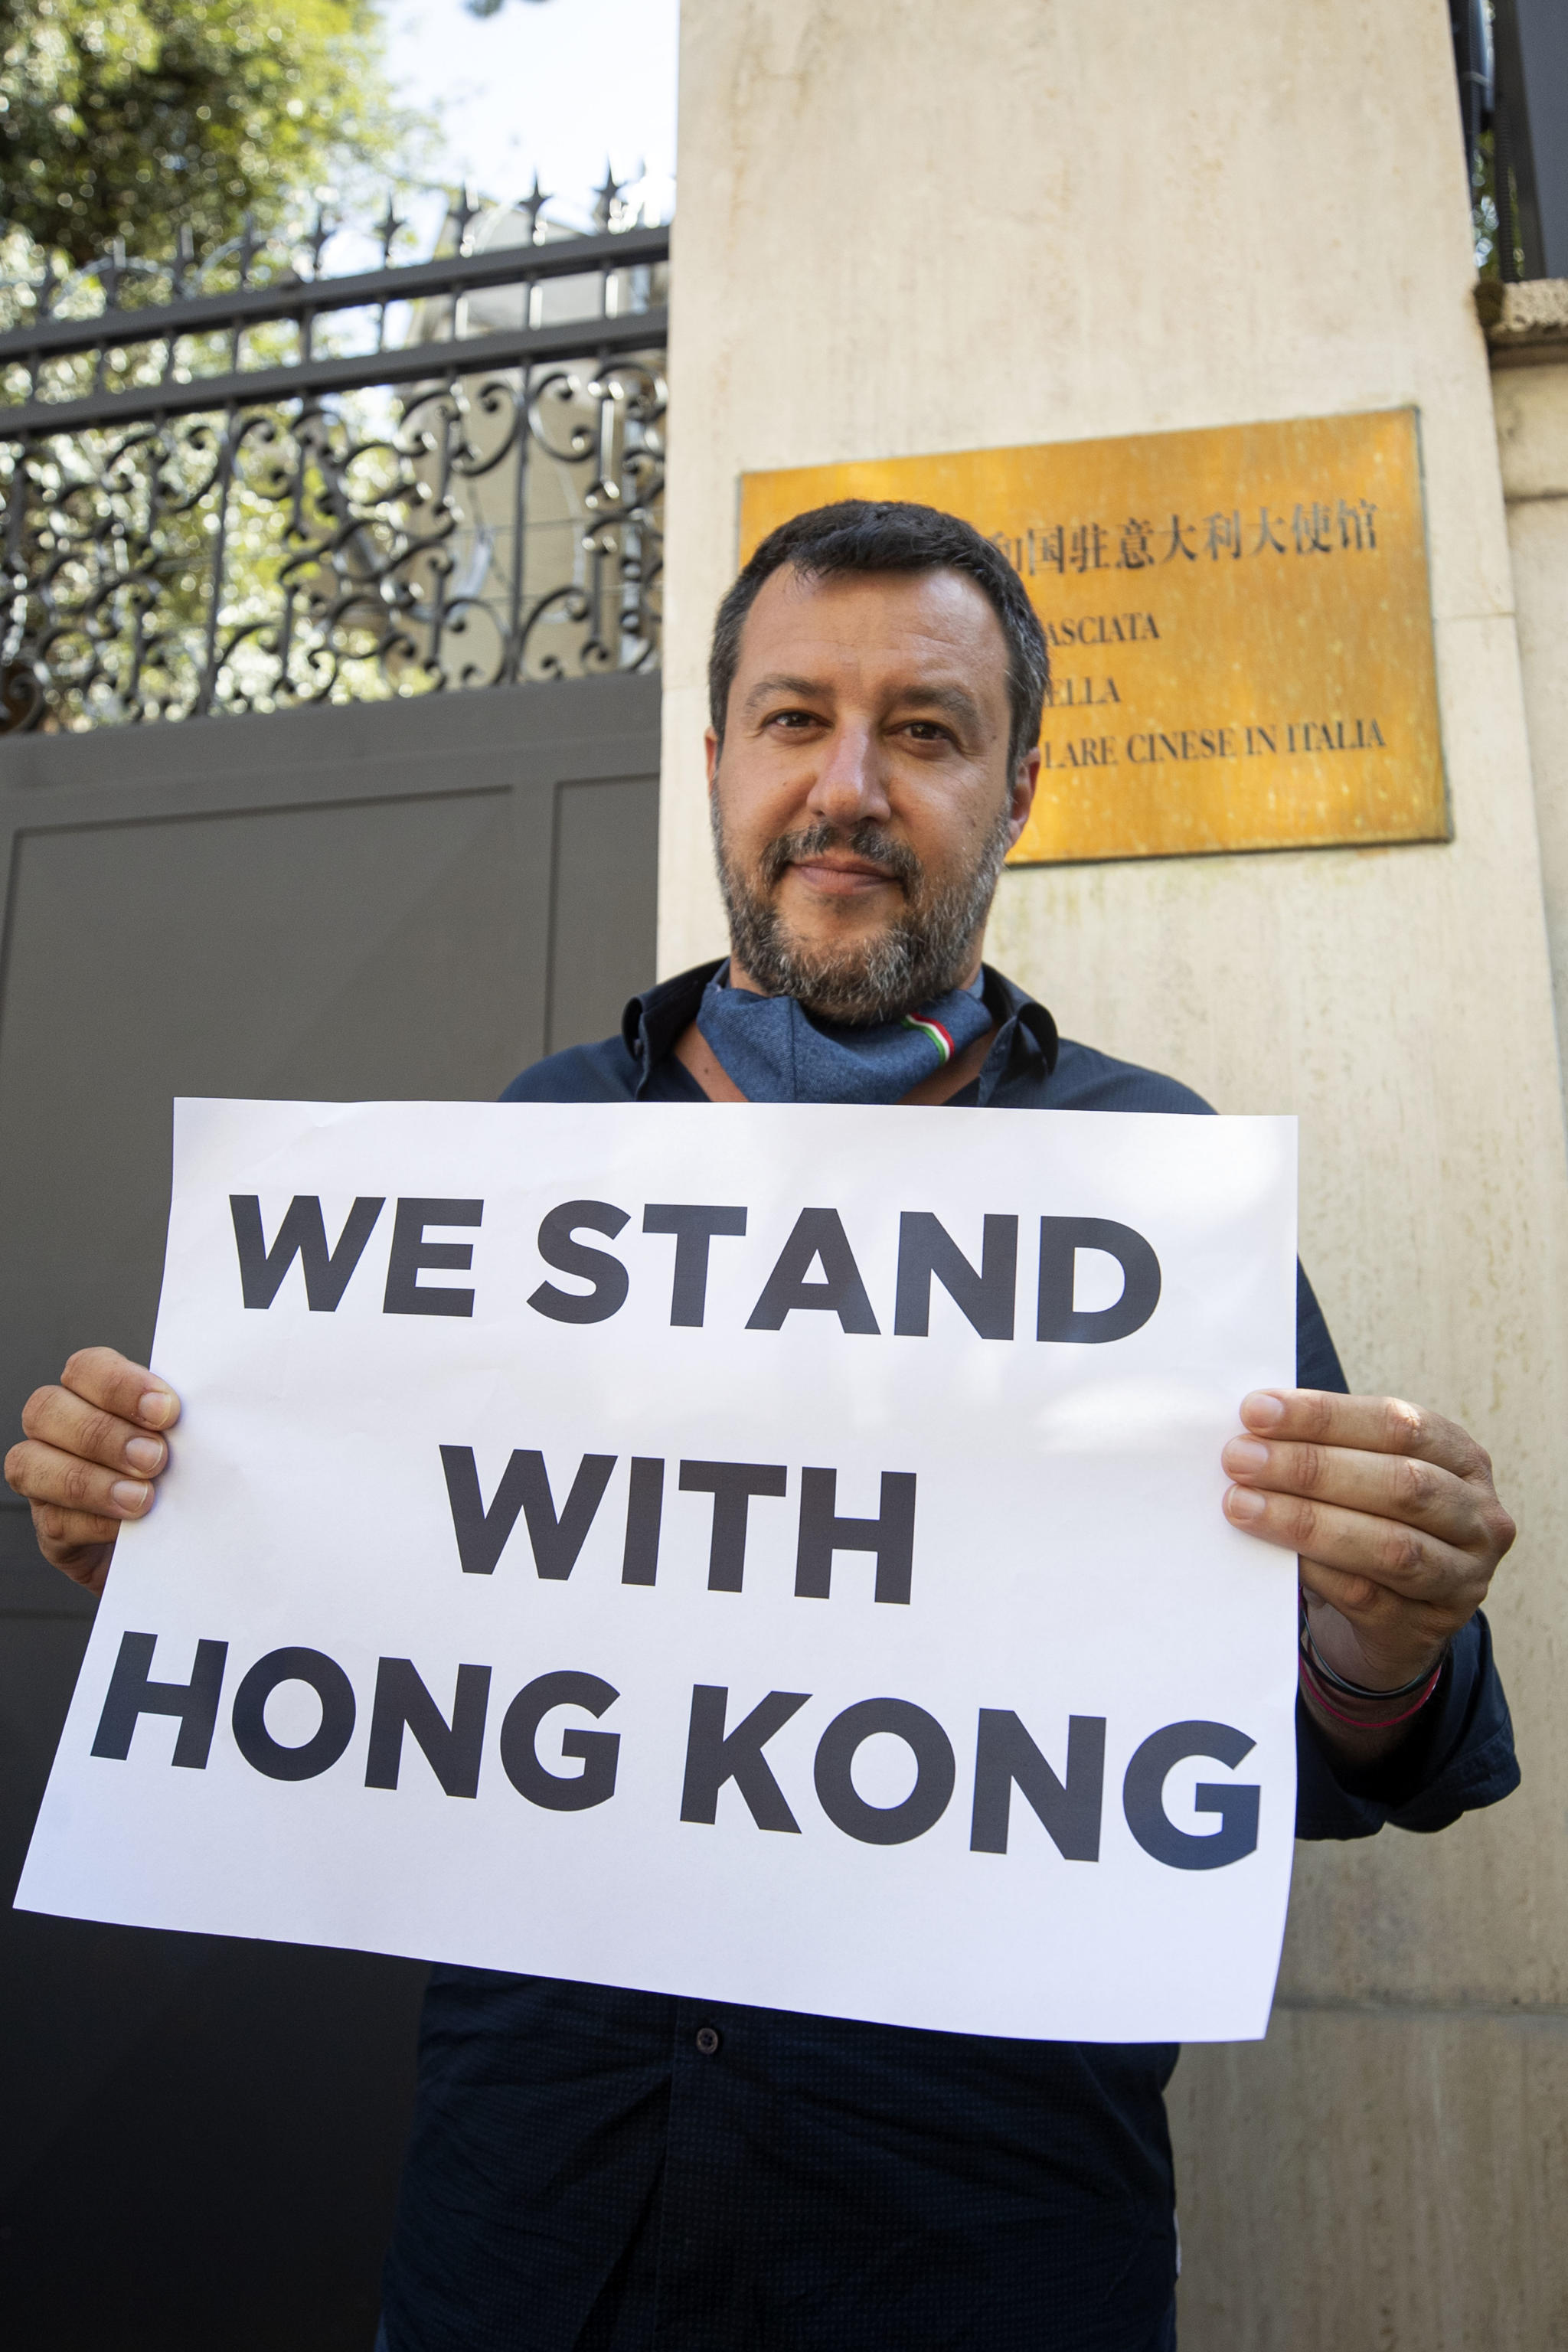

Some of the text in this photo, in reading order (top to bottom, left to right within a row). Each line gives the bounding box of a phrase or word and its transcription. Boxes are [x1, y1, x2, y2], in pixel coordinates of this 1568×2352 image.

[1046, 612, 1161, 648] ASCIATA
[1045, 717, 1387, 769] LARE CINESE IN ITALIA
[229, 1194, 1162, 1344] WE STAND
[439, 1444, 917, 1605] WITH
[90, 1631, 1262, 1870] HONG KONG
